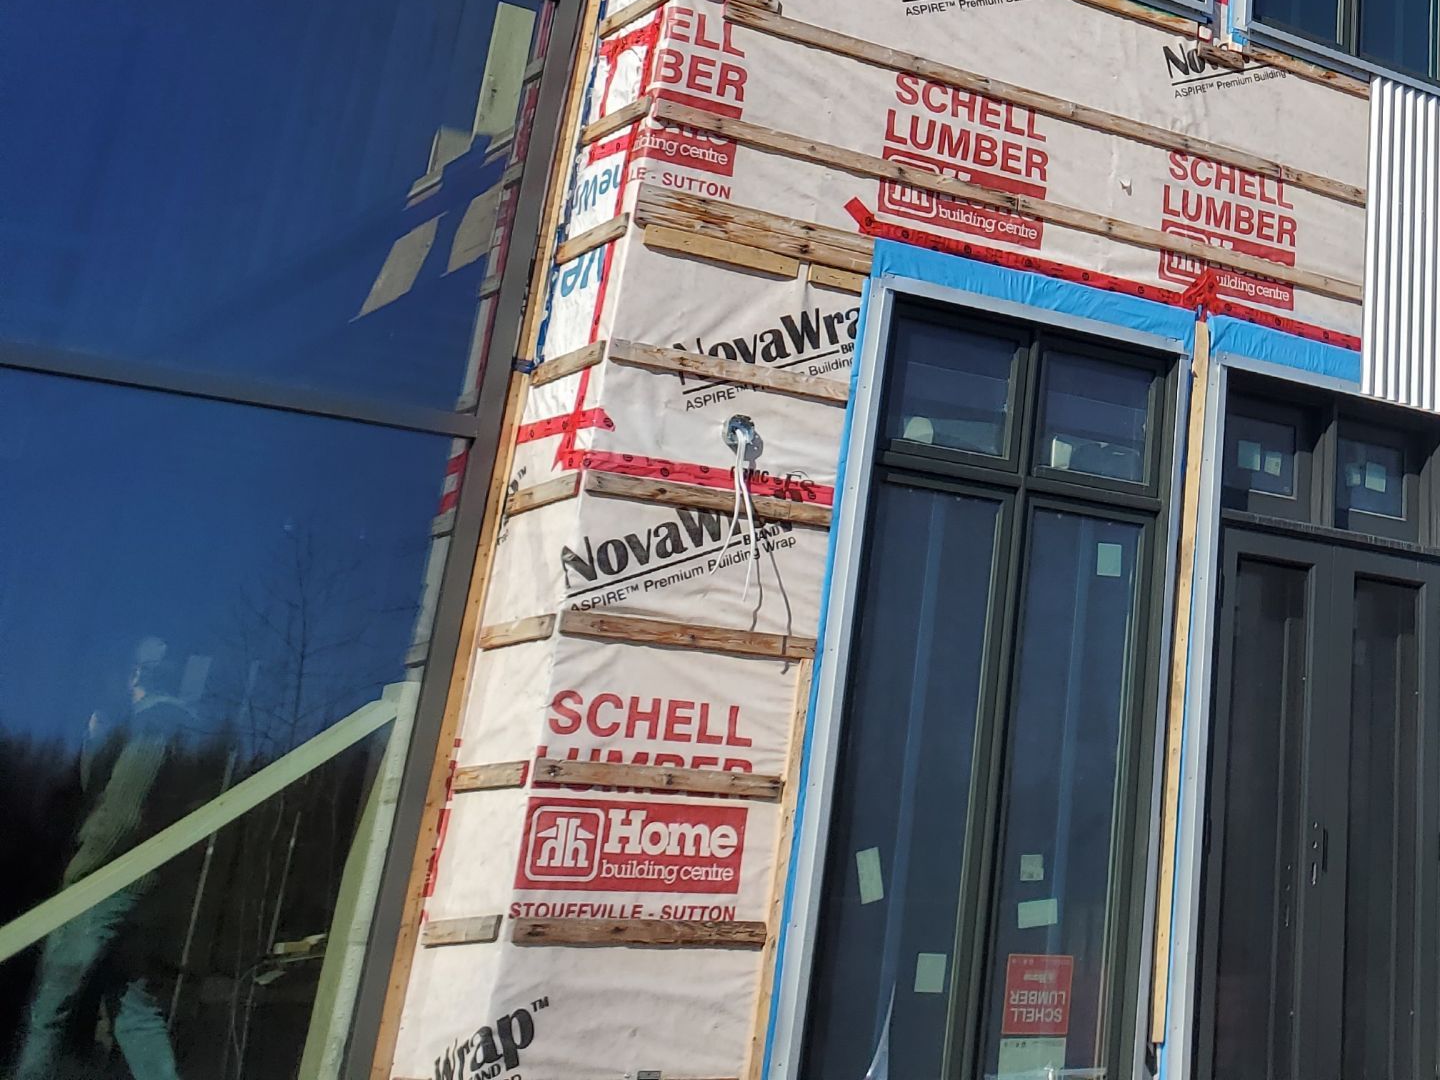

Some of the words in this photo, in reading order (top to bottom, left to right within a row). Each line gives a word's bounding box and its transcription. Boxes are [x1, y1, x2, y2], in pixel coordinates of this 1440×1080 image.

[1216, 75, 1253, 91] Premium
[1253, 70, 1287, 83] Building
[895, 71, 1047, 143] SCHELL
[679, 143, 729, 166] centre
[884, 108, 1049, 183] LUMBER
[661, 172, 732, 200] SUTTON
[1168, 150, 1294, 210] SCHELL
[938, 204, 996, 233] building
[997, 220, 1039, 241] centre
[1162, 183, 1298, 248] LUMBER
[1256, 286, 1290, 302] centre
[672, 307, 861, 385] ovaWra
[643, 565, 705, 593] Premium
[762, 535, 799, 554] Wrap
[547, 689, 753, 748] SCHELL
[603, 807, 738, 858] Home
[600, 858, 680, 885] building
[680, 864, 735, 882] centre
[508, 902, 644, 920] STOUFFVILLE
[660, 904, 736, 922] SUTTON
[1009, 990, 1066, 1005] LUMBER
[1011, 1007, 1063, 1023] SCHELL
